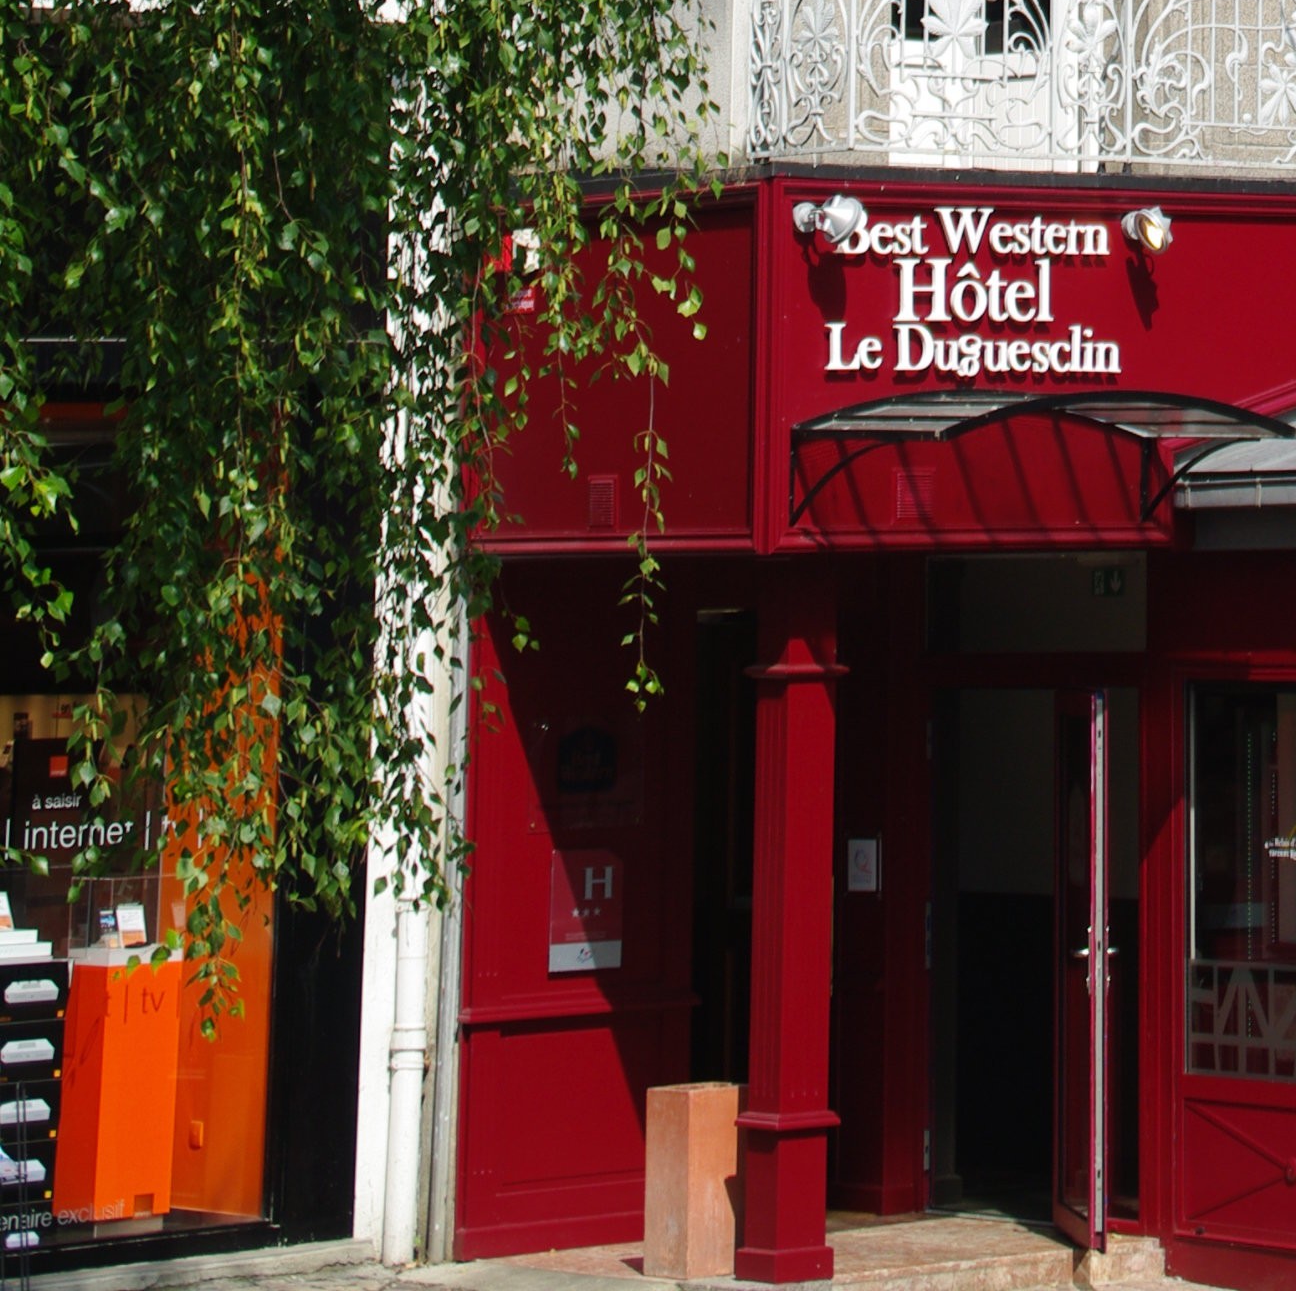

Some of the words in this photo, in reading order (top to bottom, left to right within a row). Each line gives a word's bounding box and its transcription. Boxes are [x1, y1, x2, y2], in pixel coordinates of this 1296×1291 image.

[834, 209, 929, 255] Best
[934, 206, 1110, 255] Western
[893, 257, 1054, 322] Hôtel
[824, 321, 882, 371] Le
[893, 323, 1121, 377] Duguesclin
[32, 793, 41, 810] à
[45, 793, 82, 810] saisir
[585, 866, 613, 900] H
